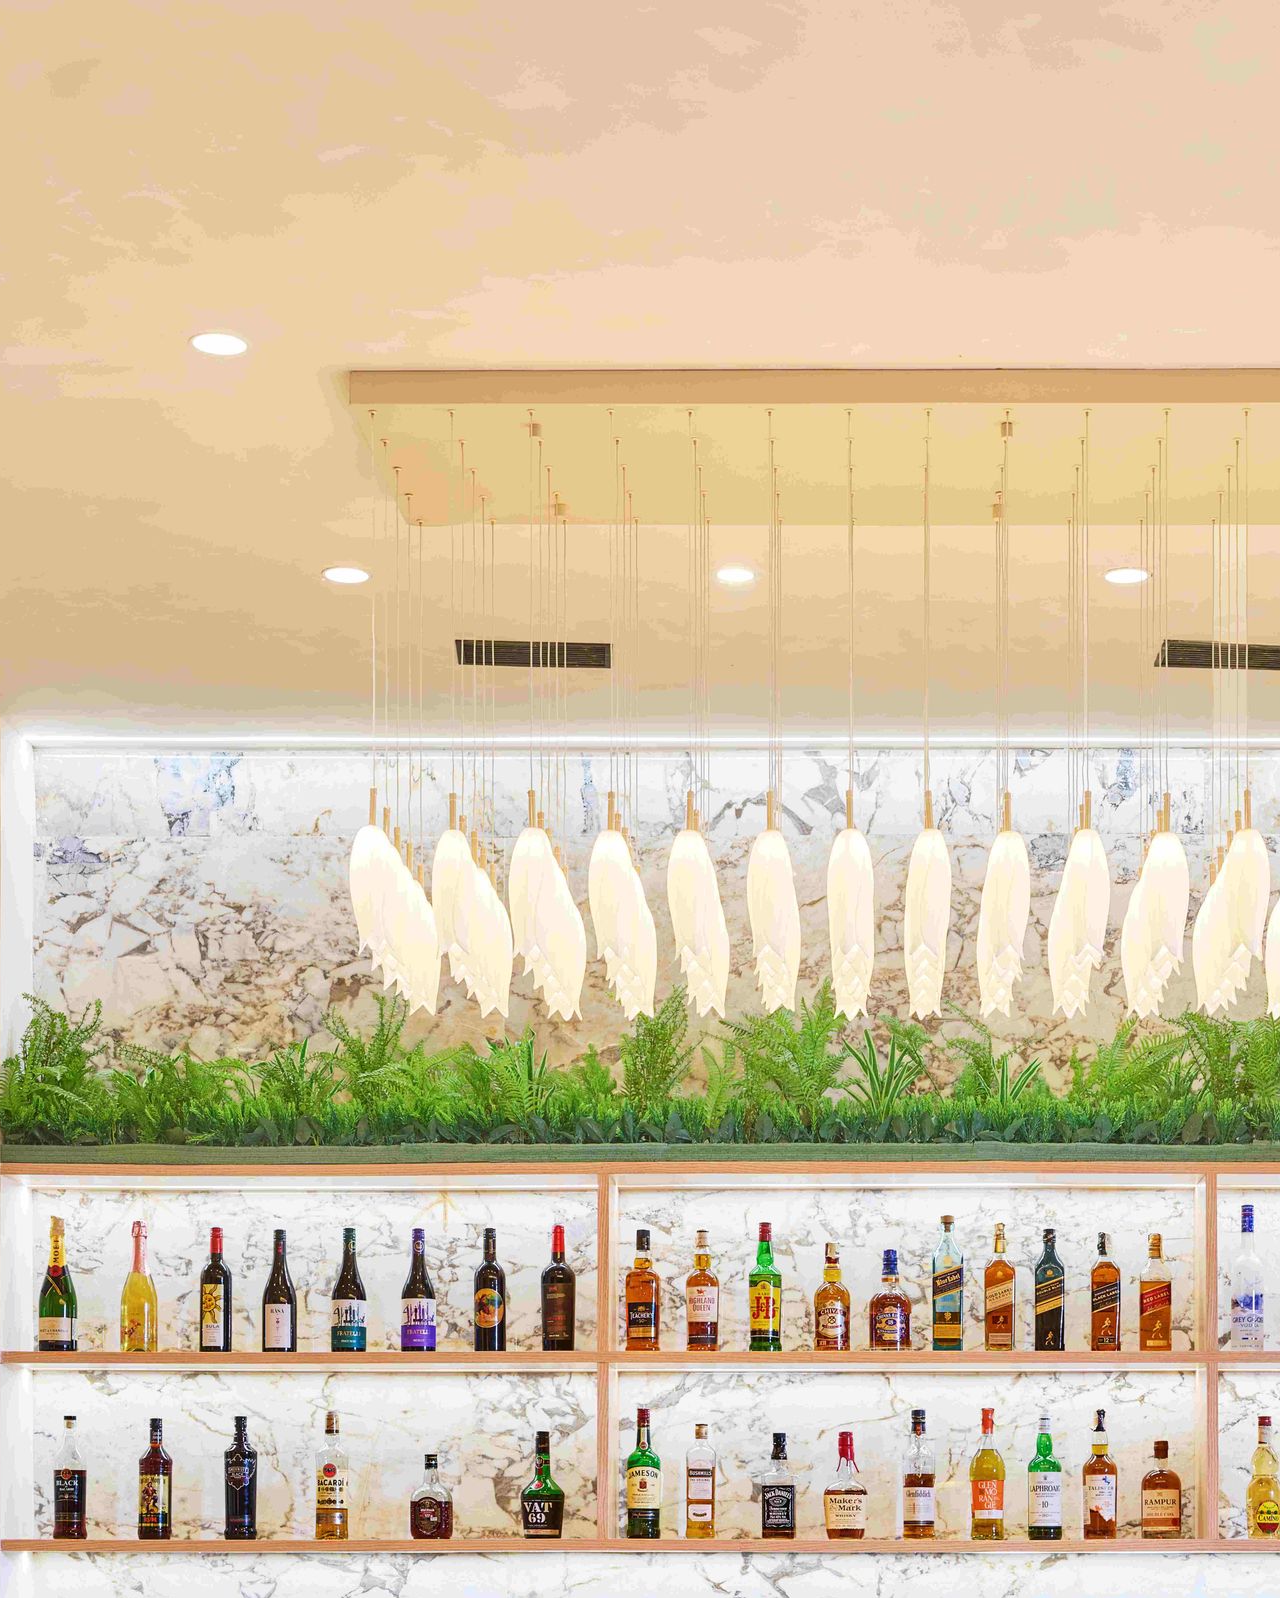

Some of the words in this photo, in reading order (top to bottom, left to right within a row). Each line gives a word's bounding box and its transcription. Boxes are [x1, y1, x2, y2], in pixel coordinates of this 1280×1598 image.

[688, 1296, 716, 1305] HIGHLAND
[1143, 1296, 1154, 1304] RED
[1154, 1291, 1170, 1300] LABEL
[692, 1302, 711, 1312] QUEEN
[752, 1296, 776, 1320] J&B
[628, 1469, 658, 1480] JAMESON
[978, 1481, 997, 1489] GLEN
[764, 1491, 776, 1500] JACK
[985, 1488, 997, 1496] MO
[978, 1495, 993, 1503] RAN
[1144, 1498, 1177, 1506] RAMPUR
[523, 1501, 553, 1513] VAT
[838, 1504, 862, 1512] Mark
[1041, 1500, 1049, 1509] 10
